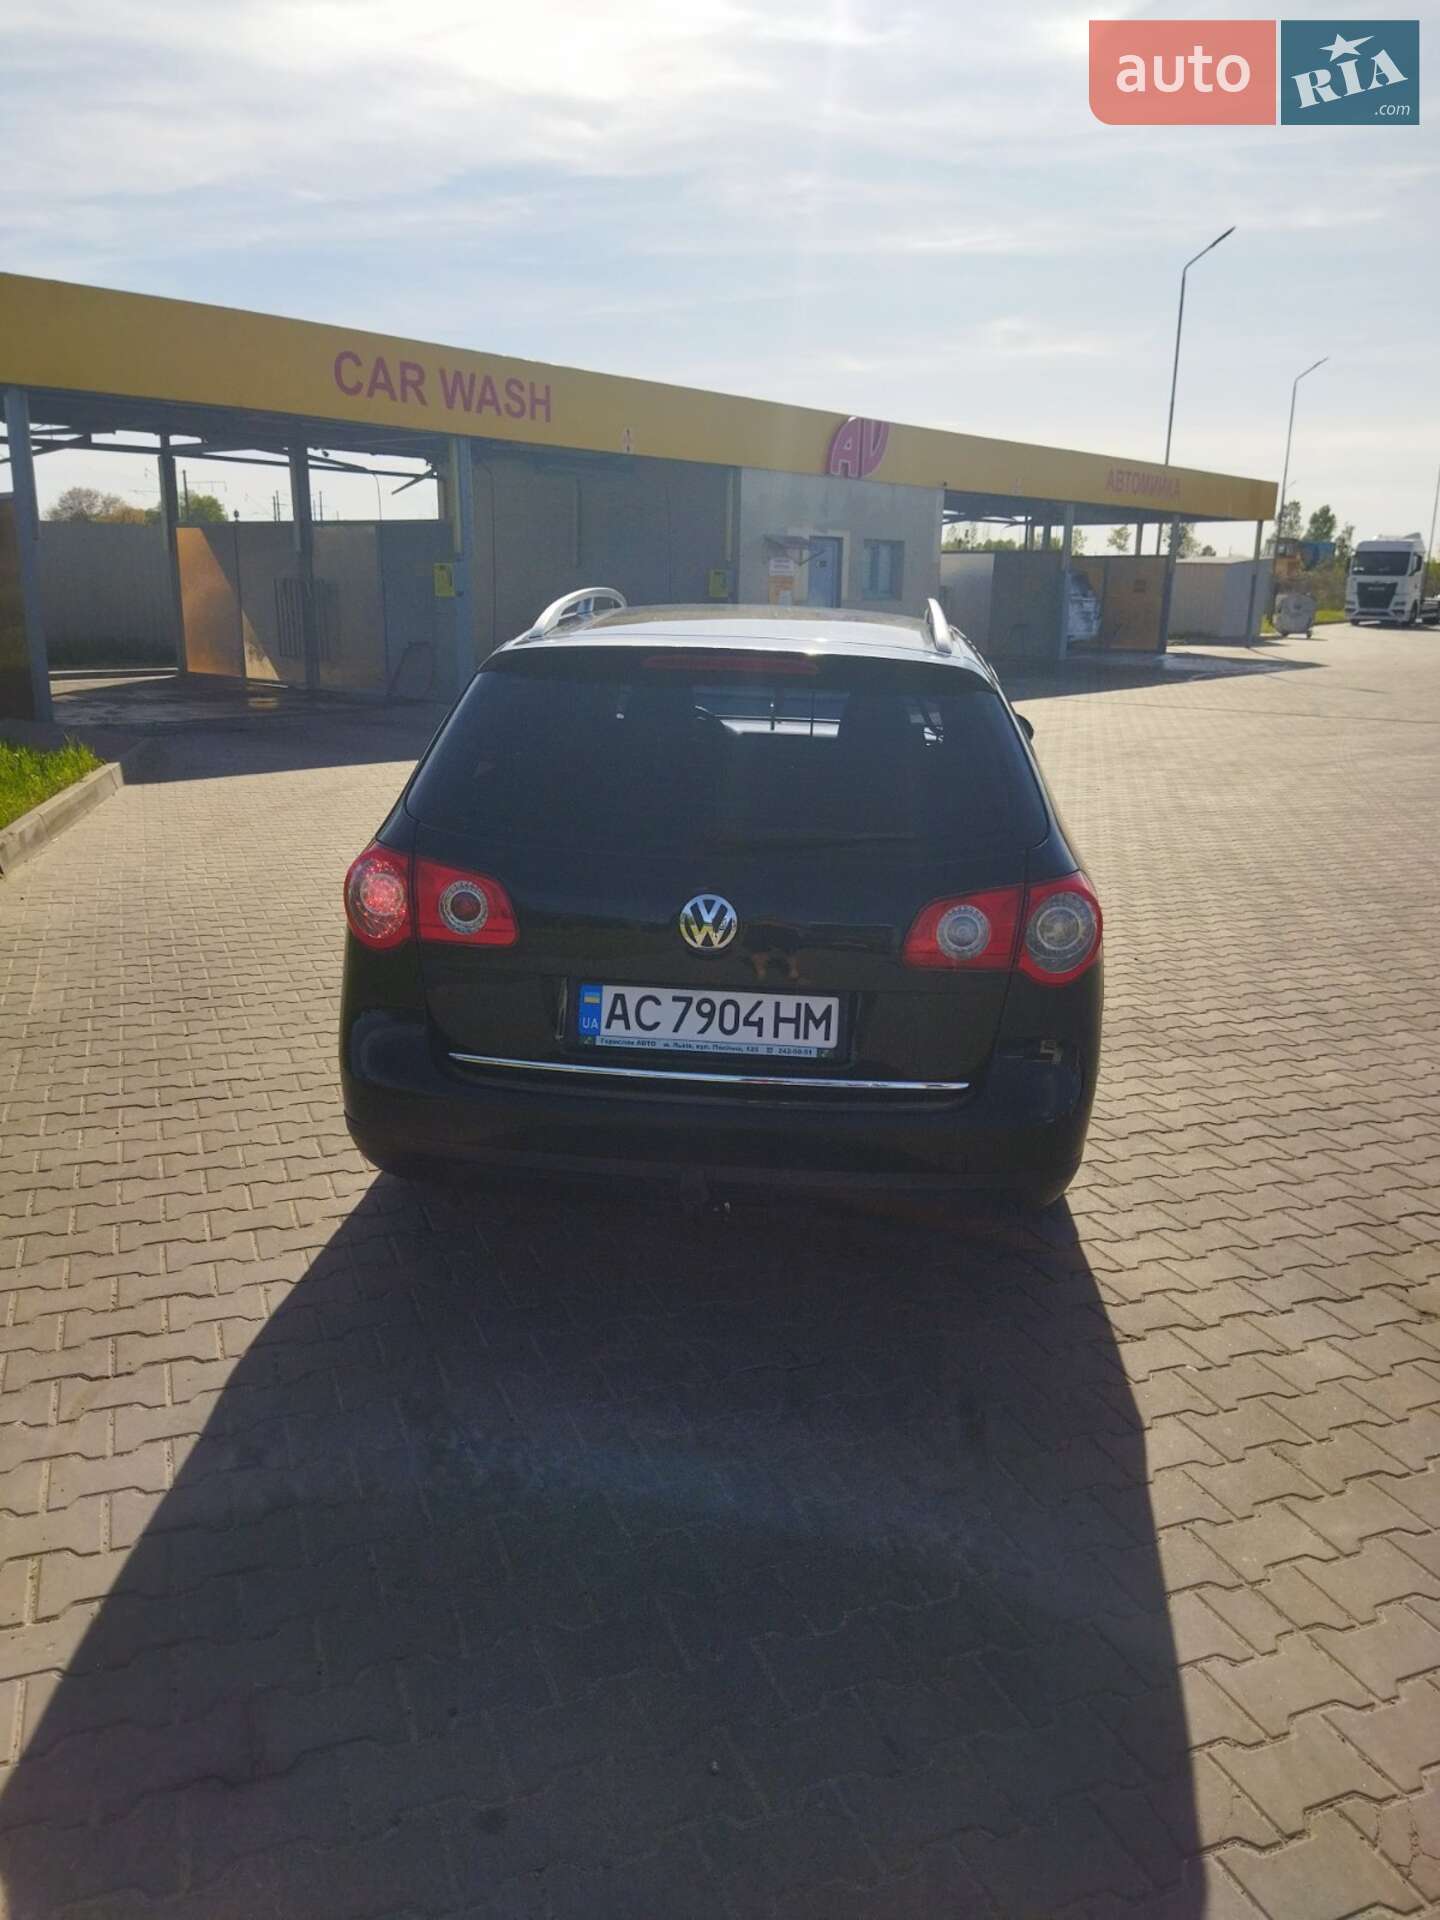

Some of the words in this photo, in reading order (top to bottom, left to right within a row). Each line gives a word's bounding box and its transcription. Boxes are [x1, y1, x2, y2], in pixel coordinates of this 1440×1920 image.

[334, 350, 428, 407] CAR
[439, 367, 551, 423] WASH
[582, 1016, 599, 1030] UA
